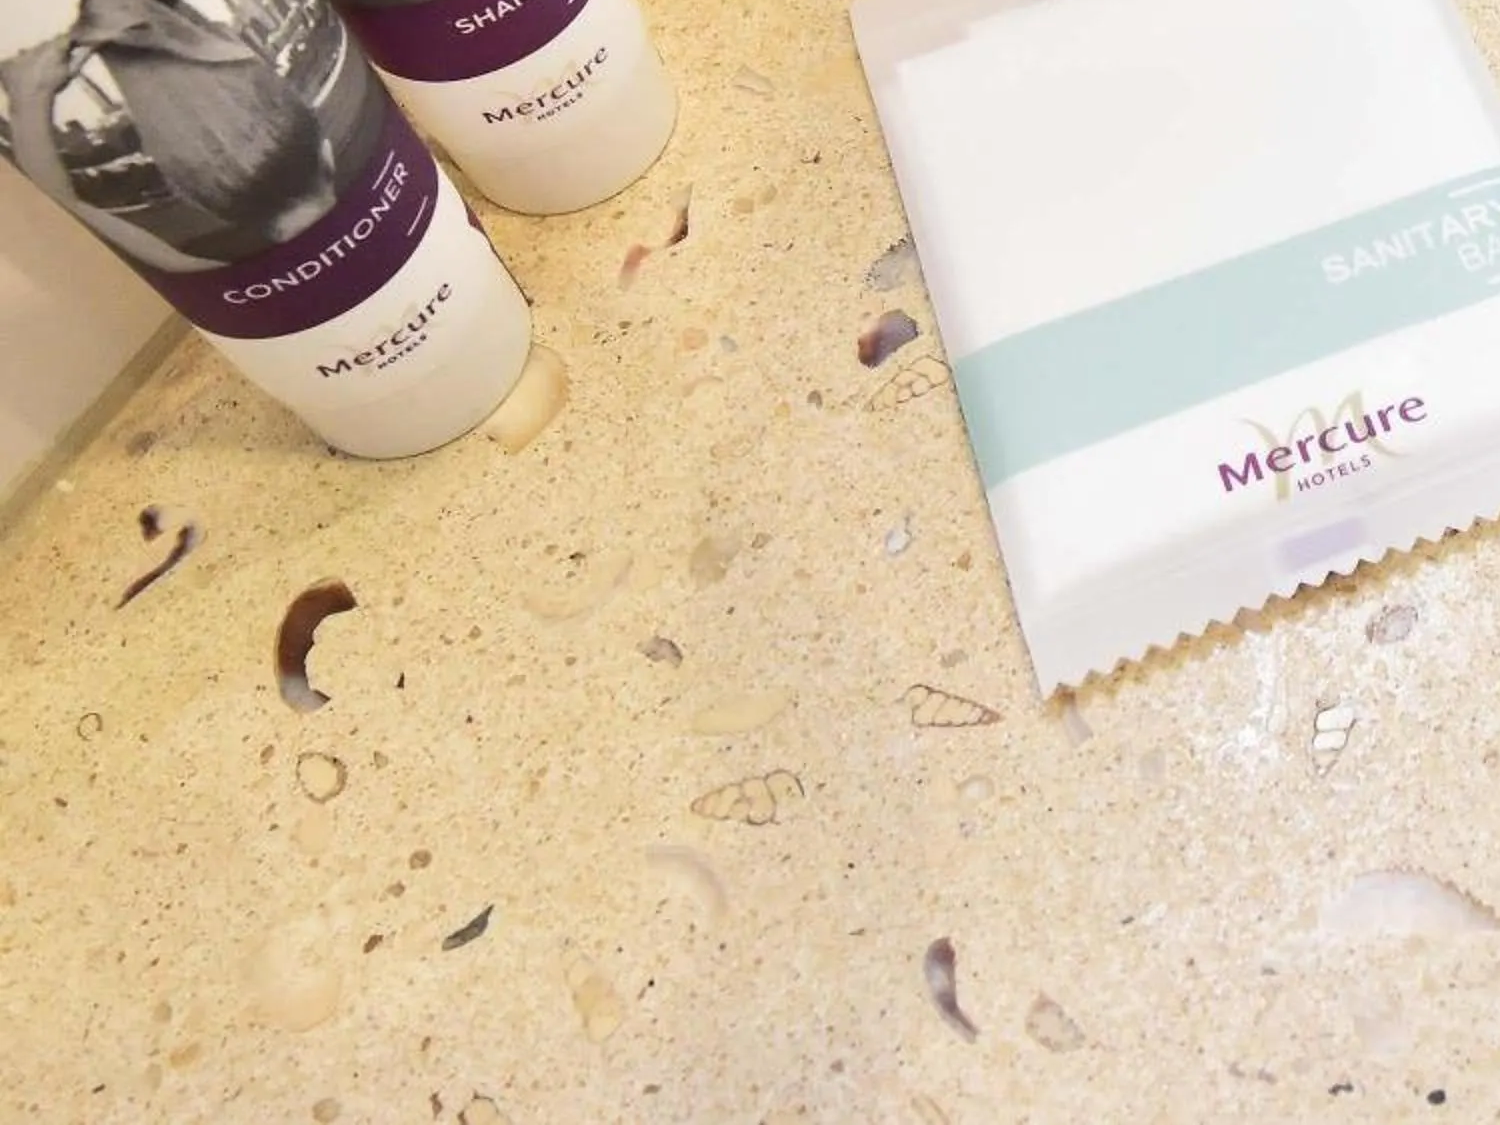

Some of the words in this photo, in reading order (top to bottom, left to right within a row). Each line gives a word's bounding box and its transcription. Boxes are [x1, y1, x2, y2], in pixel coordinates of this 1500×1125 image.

[483, 45, 609, 125] Mercure
[537, 91, 584, 121] HOTELS
[223, 161, 409, 304] CONDITIONER
[316, 281, 452, 378] Mercure
[376, 334, 428, 371] HOTELS
[1217, 396, 1428, 492] Mercure
[1297, 453, 1372, 492] HOTELS
